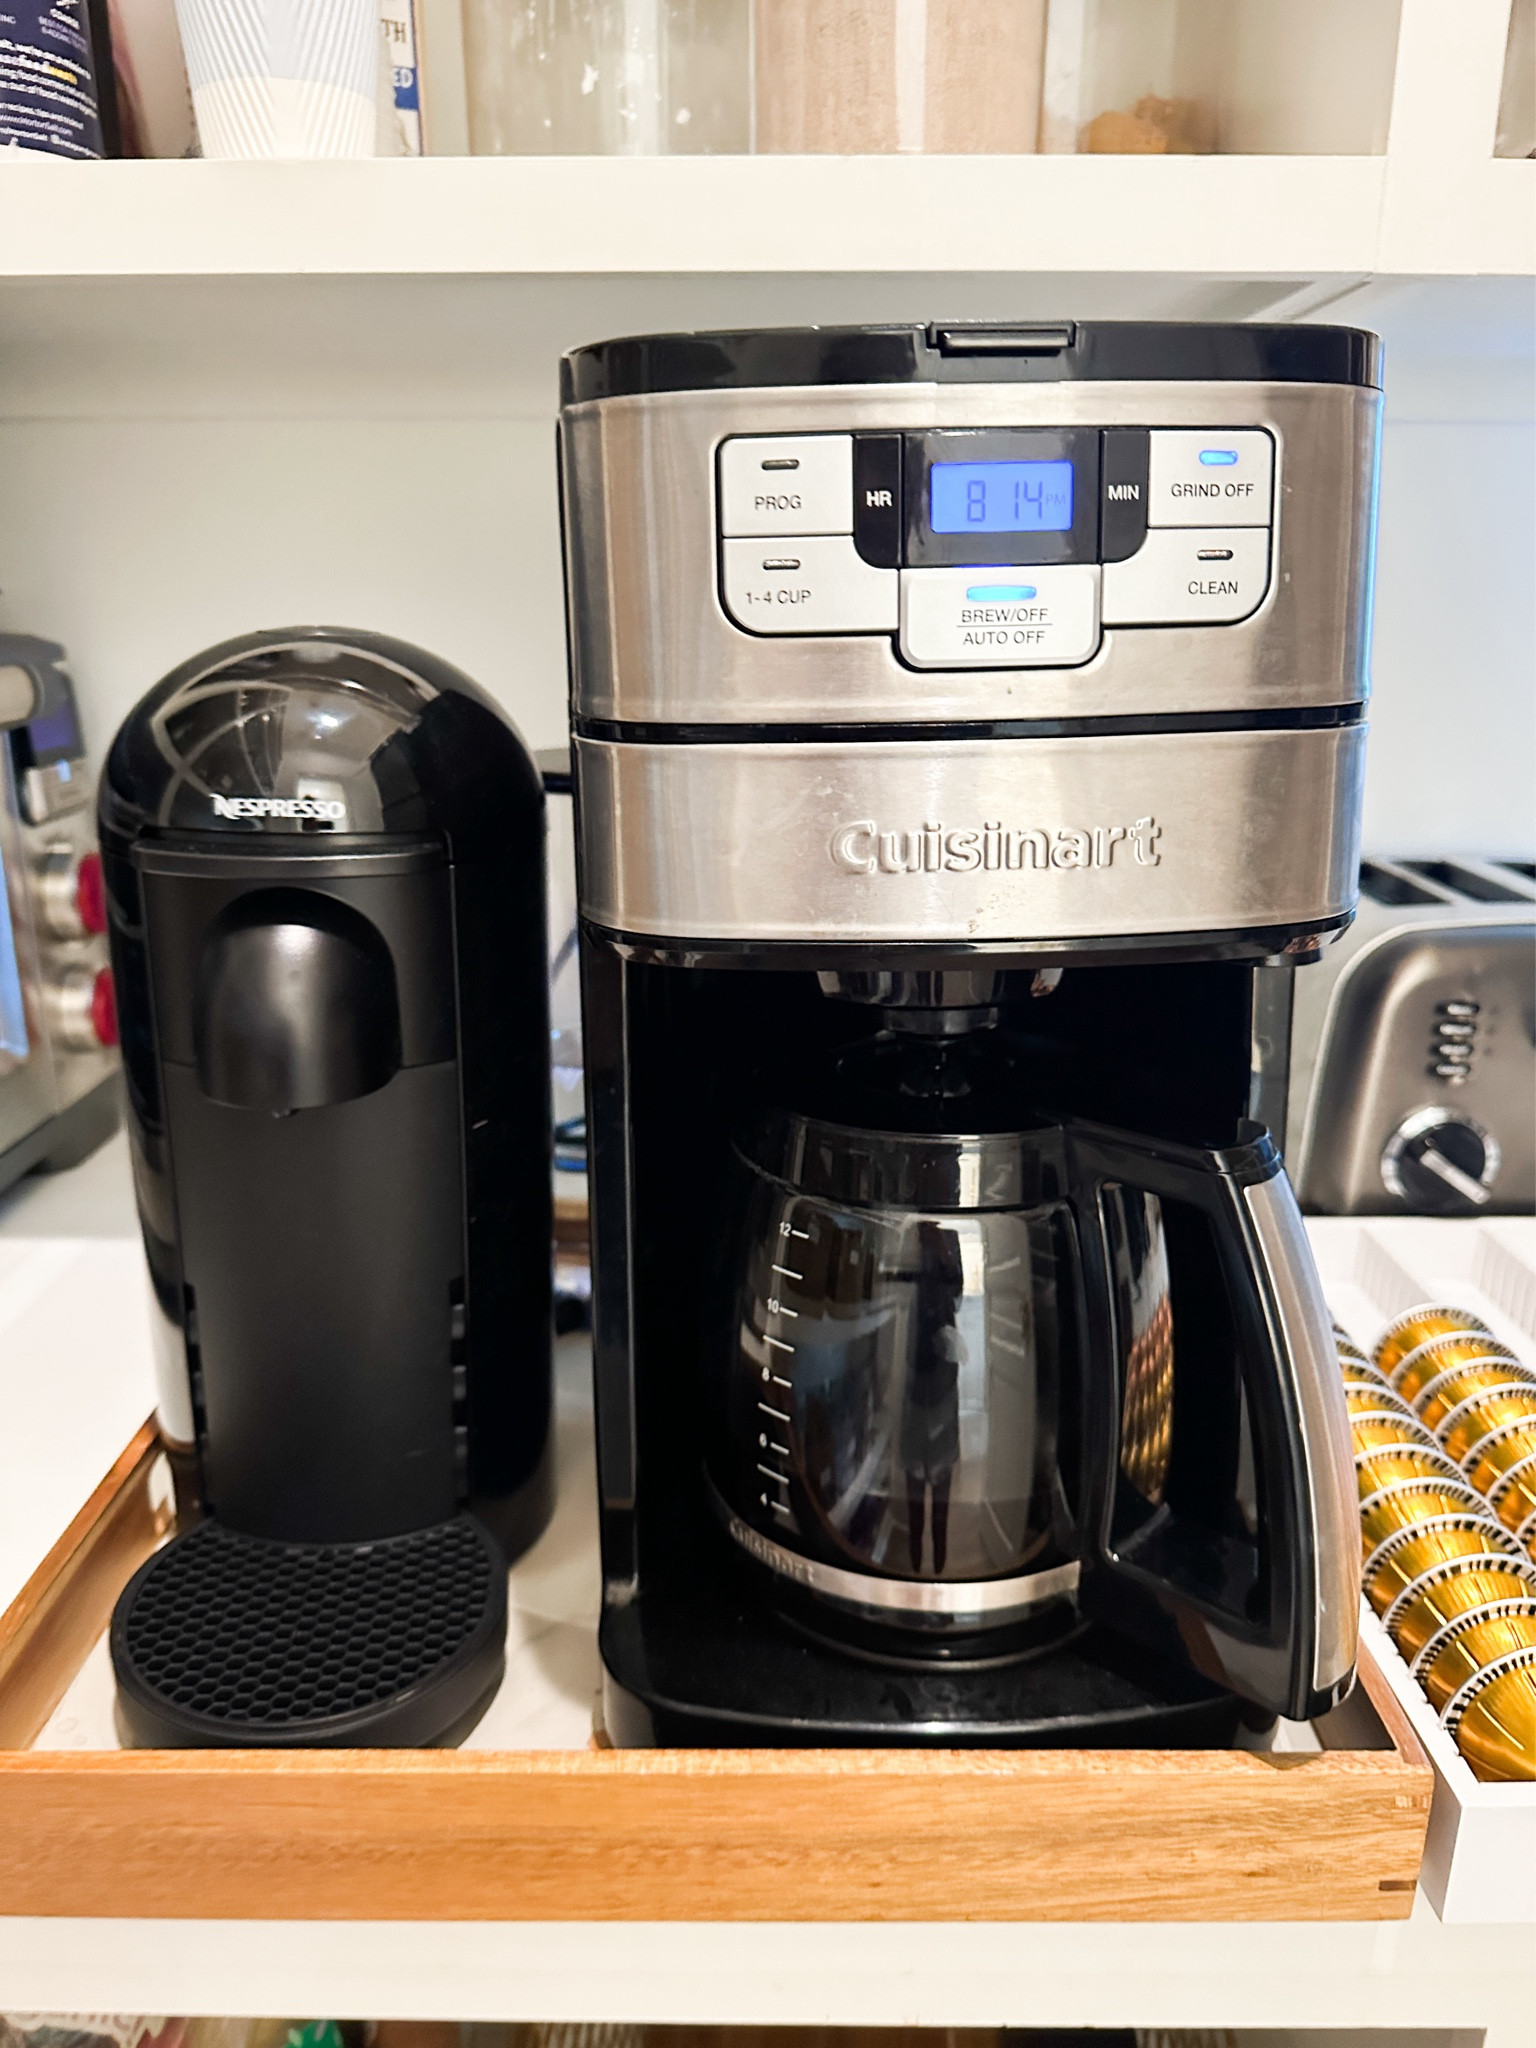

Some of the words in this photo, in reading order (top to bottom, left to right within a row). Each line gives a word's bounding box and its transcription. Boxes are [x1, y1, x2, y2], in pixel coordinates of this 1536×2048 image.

[866, 490, 892, 507] HR
[1108, 485, 1139, 500] MIN
[1171, 484, 1220, 497] GRIND
[1225, 484, 1254, 497] OFF
[754, 495, 801, 511] PROG
[967, 480, 985, 522] 8
[1014, 481, 1042, 519] 14
[1045, 494, 1066, 505] PM
[1188, 581, 1238, 595] CLEAN
[777, 590, 811, 604] CUP
[961, 608, 1048, 623] BREW/OFF
[963, 631, 1008, 645] AUTO
[1013, 631, 1045, 644] OFF
[209, 793, 346, 820] NESPRESSO
[829, 816, 1162, 874] Cuisinart
[779, 1221, 792, 1237] 12
[767, 1297, 780, 1314] 10
[761, 1366, 770, 1382] 8
